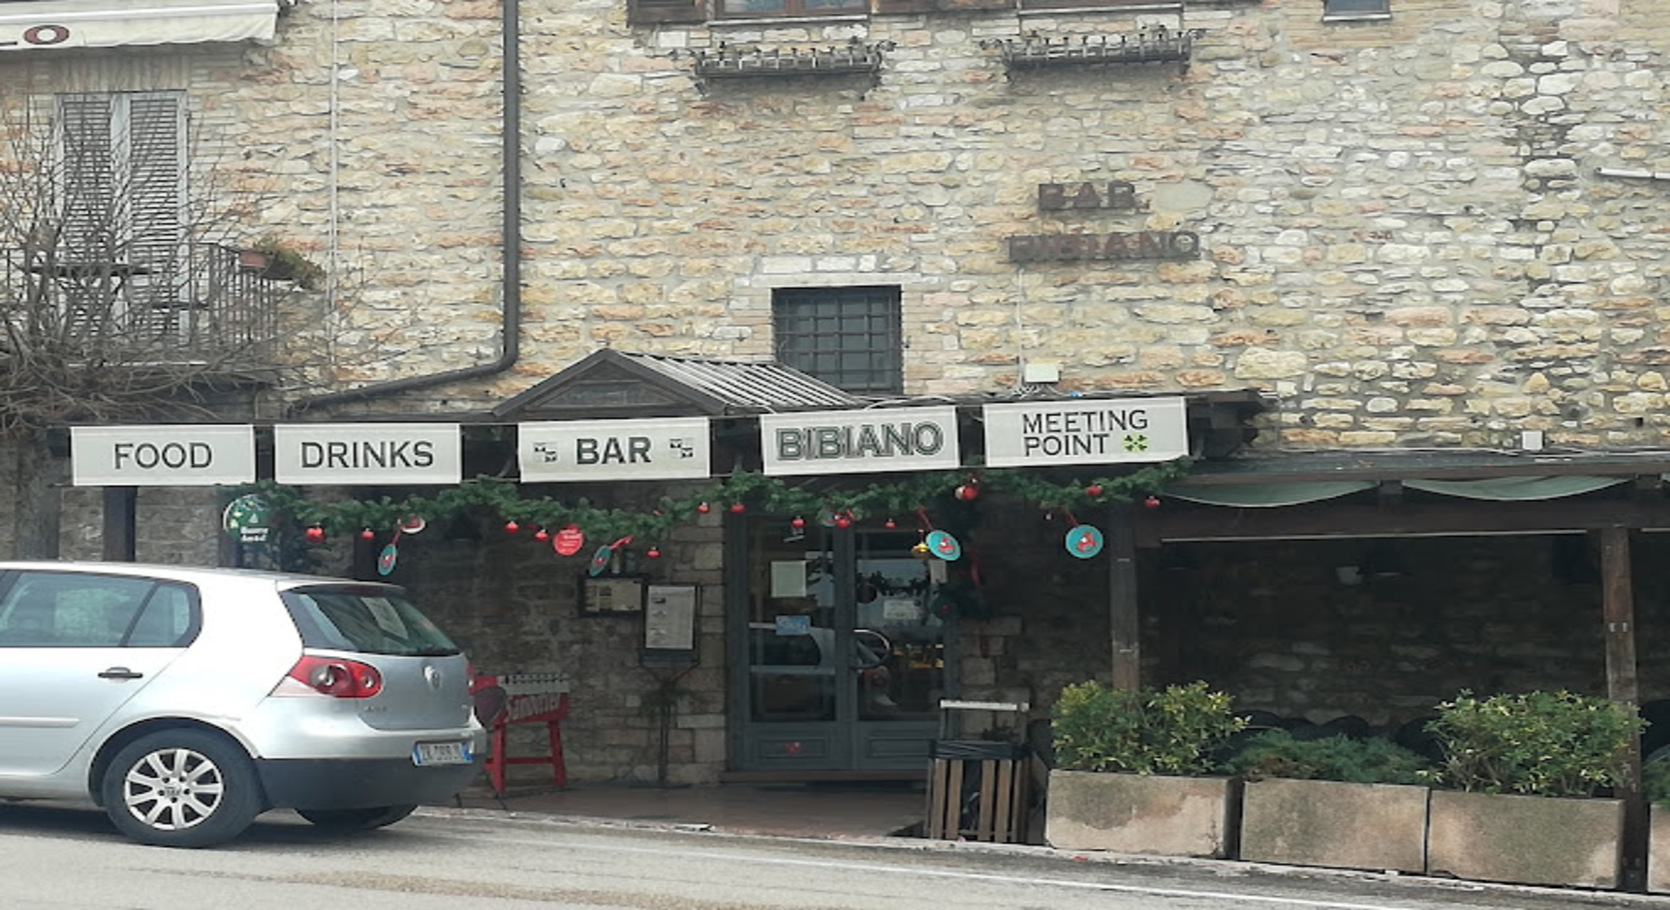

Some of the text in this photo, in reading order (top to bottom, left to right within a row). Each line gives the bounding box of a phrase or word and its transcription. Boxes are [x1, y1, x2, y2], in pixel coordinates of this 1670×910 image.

[0, 25, 69, 45] O
[1039, 181, 1136, 210] BAR
[1022, 409, 1148, 434] MEETING
[301, 441, 434, 468] DRINKS
[576, 436, 652, 465] BAR
[775, 421, 944, 461] BIBIANO
[1023, 433, 1110, 457] POINT
[114, 442, 213, 470] FOOD
